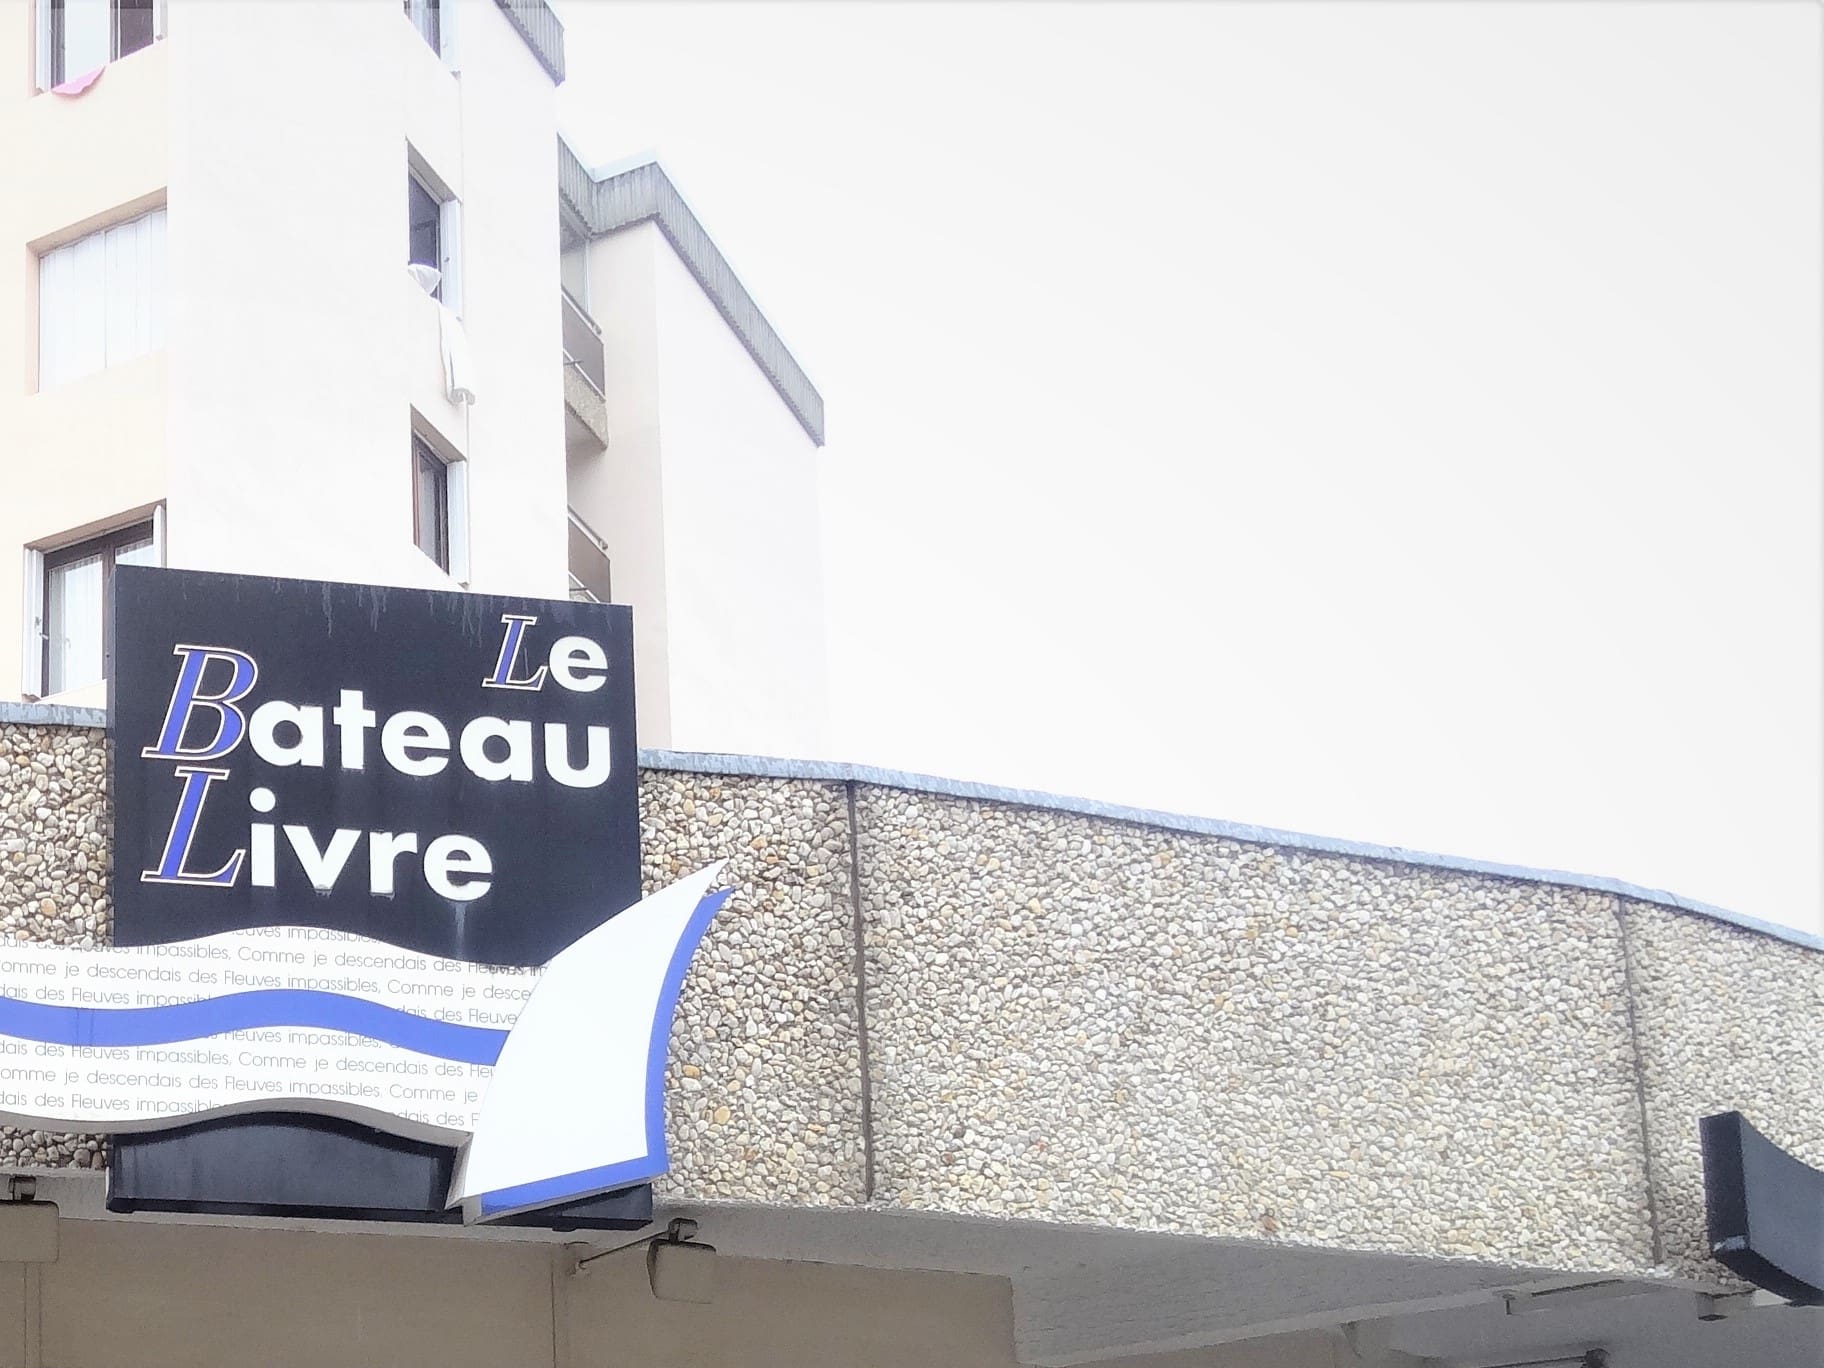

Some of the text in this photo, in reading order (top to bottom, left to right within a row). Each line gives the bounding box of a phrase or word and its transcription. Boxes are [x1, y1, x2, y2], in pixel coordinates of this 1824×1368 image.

[482, 613, 609, 694] Le
[142, 644, 612, 789] Bateau
[142, 768, 493, 902] Livre
[238, 946, 305, 964] Comme
[313, 950, 328, 967] je
[334, 952, 427, 972] descendais
[433, 957, 462, 973] des
[64, 961, 79, 979] je
[87, 963, 181, 982] descendais
[188, 969, 217, 984] des
[224, 970, 281, 988] Fleuves
[287, 974, 381, 994] impassibles,
[387, 979, 453, 997] Comme
[462, 983, 475, 1000] je
[35, 985, 65, 1001] des
[72, 987, 129, 1005] Fleuves
[434, 1007, 462, 1022] des
[35, 1042, 65, 1058] des
[136, 1047, 232, 1067] impassibles,
[238, 1051, 306, 1069] Comme
[314, 1054, 328, 1072] je
[336, 1056, 428, 1076] descendais
[435, 1061, 464, 1077] des
[64, 1068, 79, 1085] je
[87, 1070, 181, 1089] descendais
[188, 1074, 218, 1090] des
[225, 1075, 283, 1093] Fleuves
[389, 1084, 456, 1102] Comme
[464, 1089, 478, 1105] je
[35, 1092, 65, 1108] des
[71, 1094, 129, 1111] Fleuves
[436, 1111, 465, 1126] des
